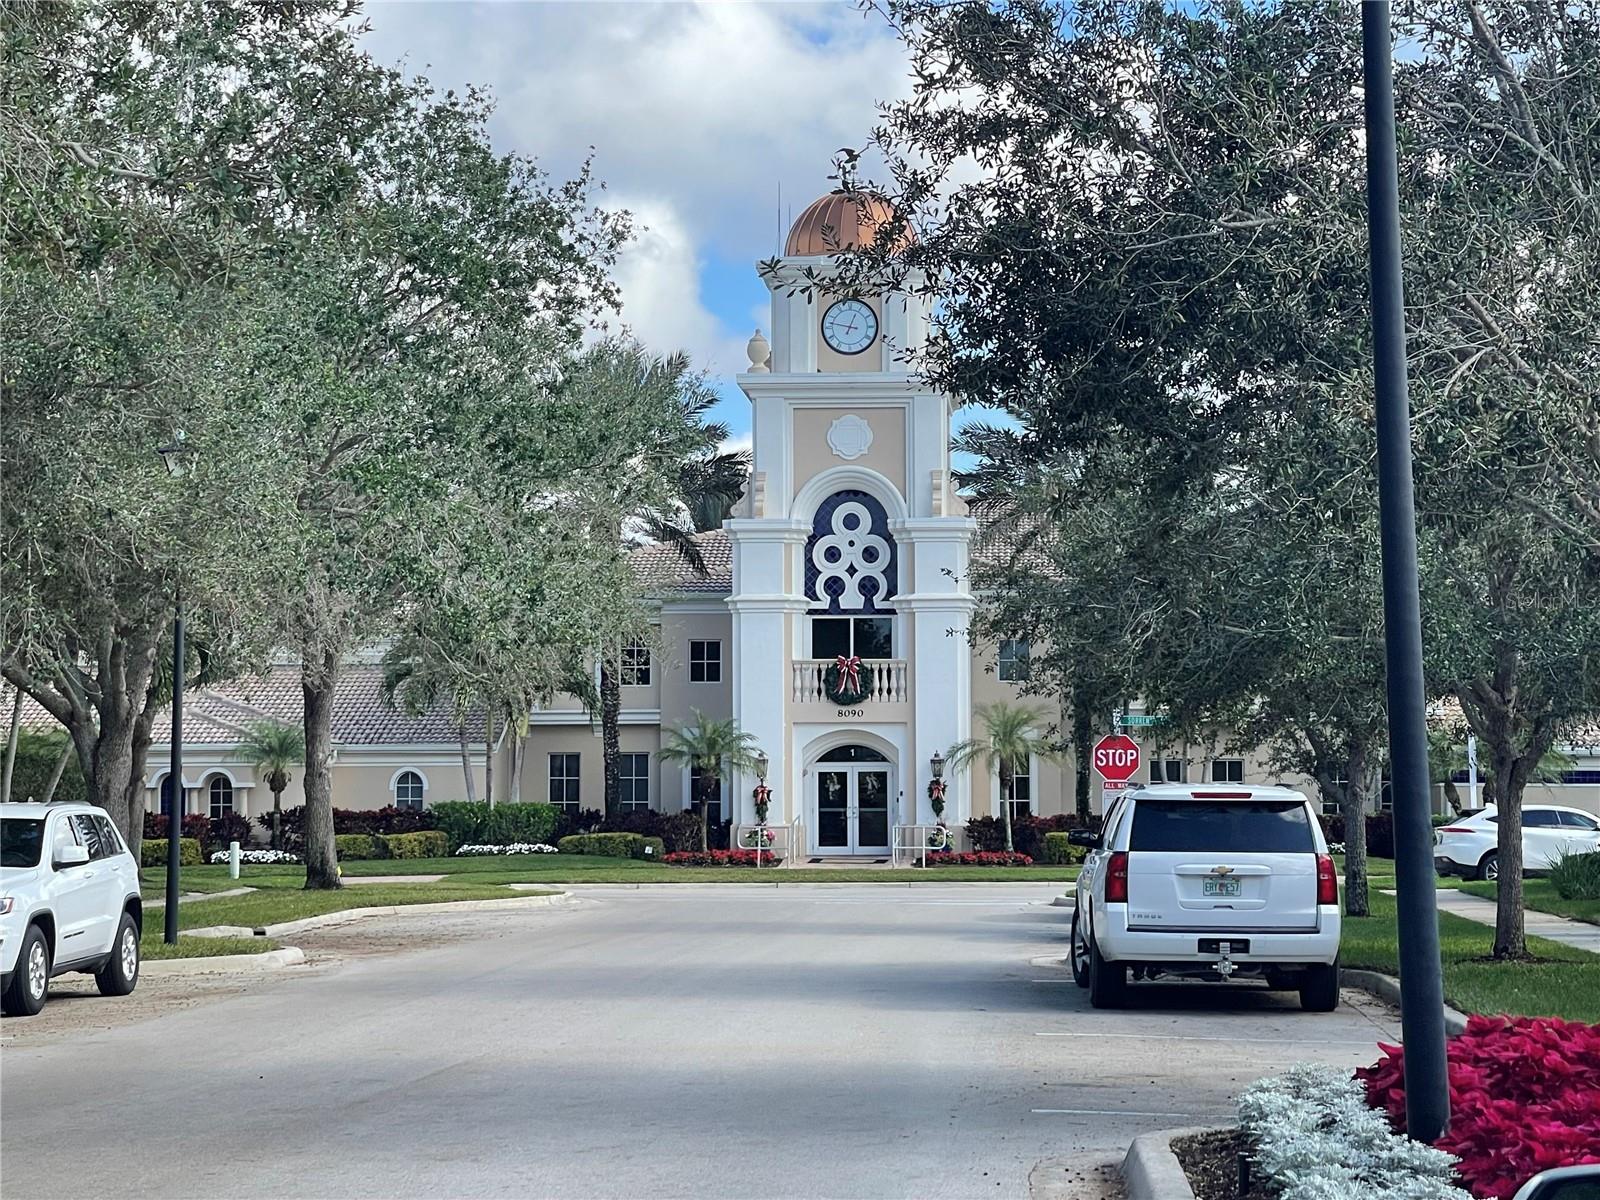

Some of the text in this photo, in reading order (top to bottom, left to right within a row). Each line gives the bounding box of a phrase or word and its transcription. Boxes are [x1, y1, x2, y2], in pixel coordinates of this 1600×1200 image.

[837, 709, 864, 718] 8090
[850, 748, 855, 757] 1
[1096, 749, 1137, 767] STOP
